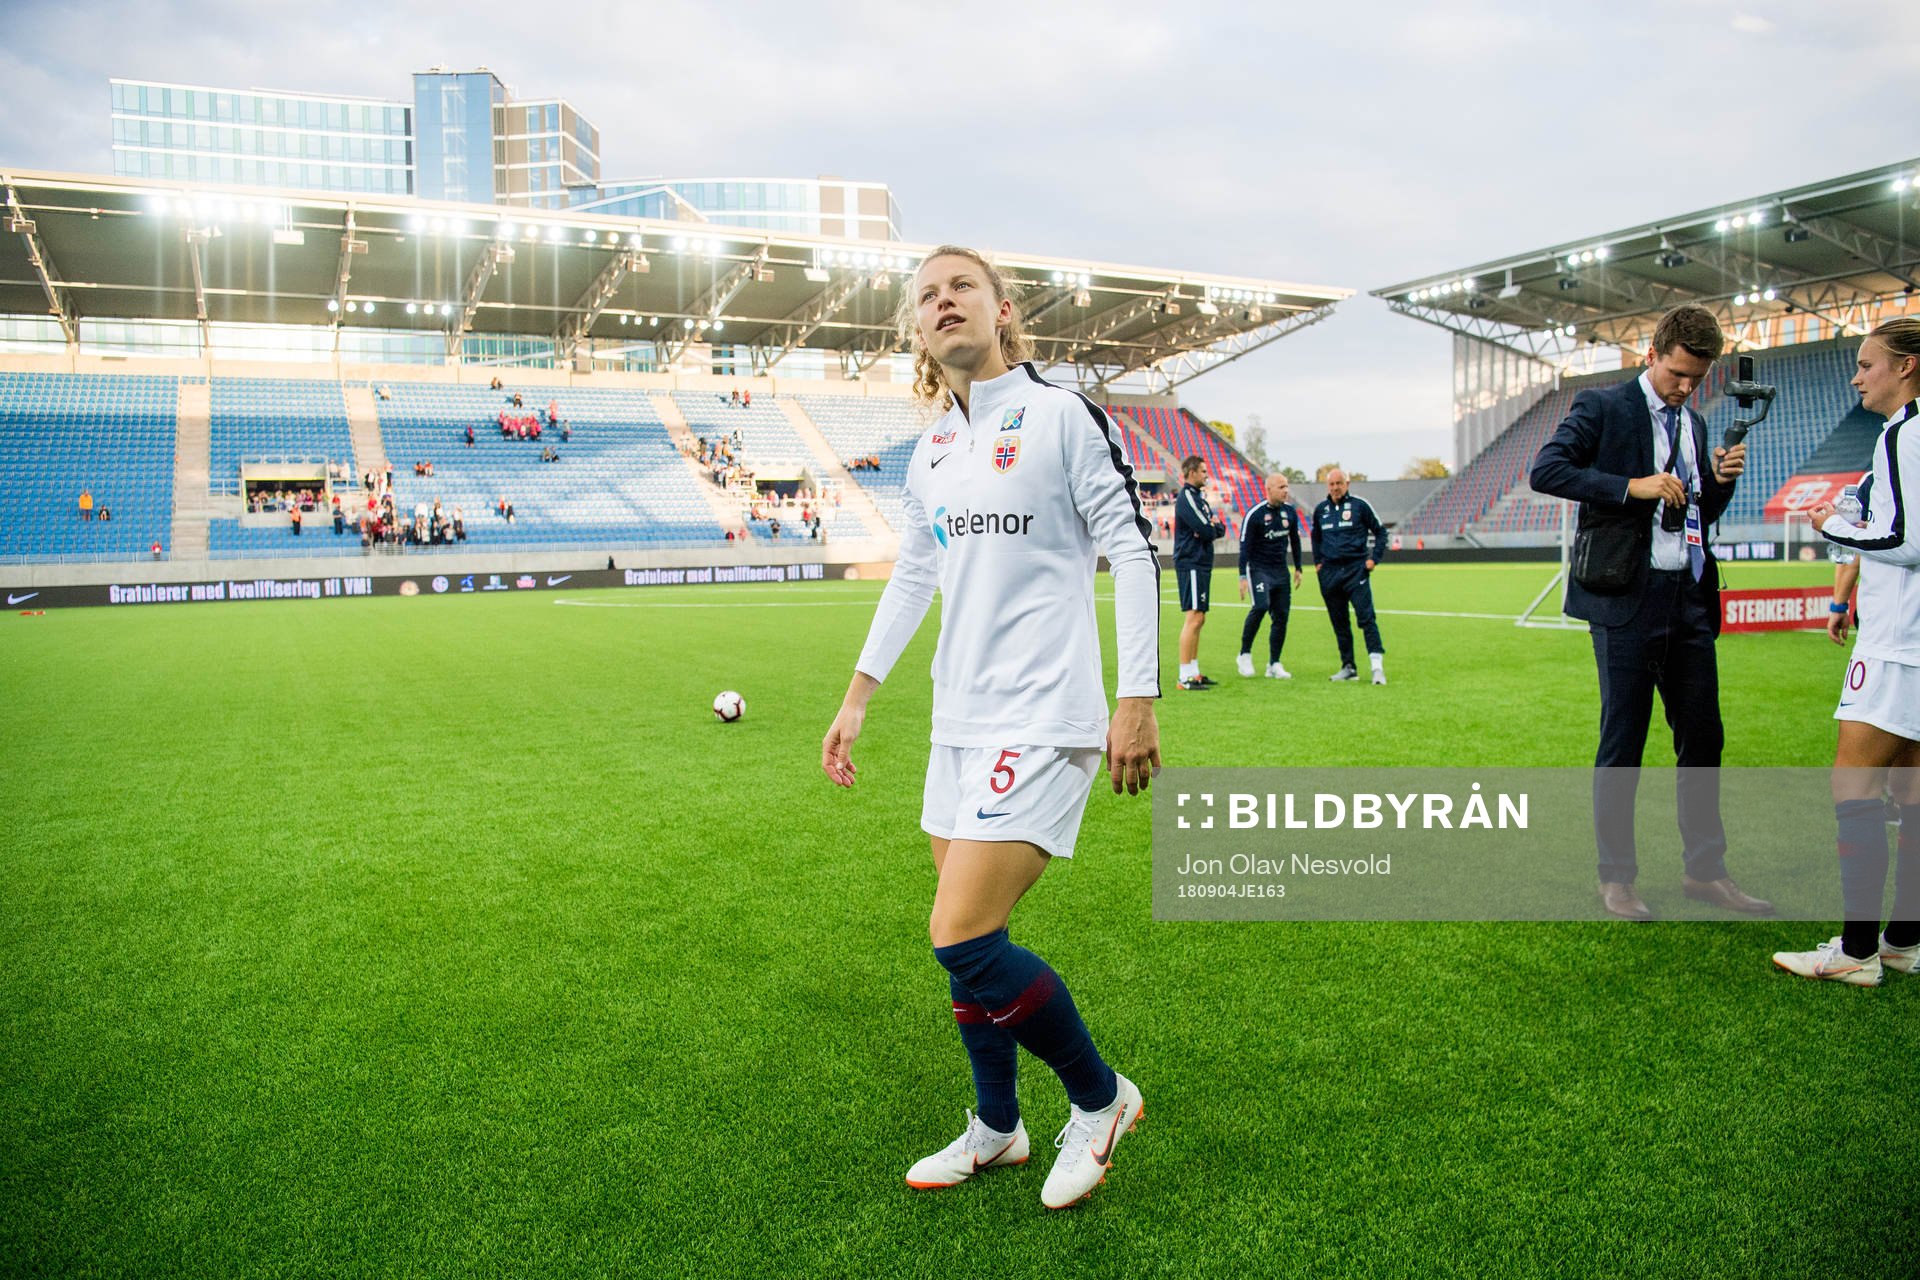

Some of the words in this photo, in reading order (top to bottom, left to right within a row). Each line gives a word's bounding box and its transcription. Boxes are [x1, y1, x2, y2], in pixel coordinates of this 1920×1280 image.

[946, 508, 1034, 537] telenor
[624, 568, 685, 585] Gratulerer
[686, 566, 713, 583] med
[109, 584, 189, 603] Gratulerer
[191, 581, 225, 600] med
[228, 579, 321, 599] kvalifisering
[324, 578, 341, 596] til
[344, 577, 372, 595] VM!
[1726, 597, 1803, 624] STERKERE
[1844, 659, 1866, 691] 10
[990, 750, 1021, 794] 5
